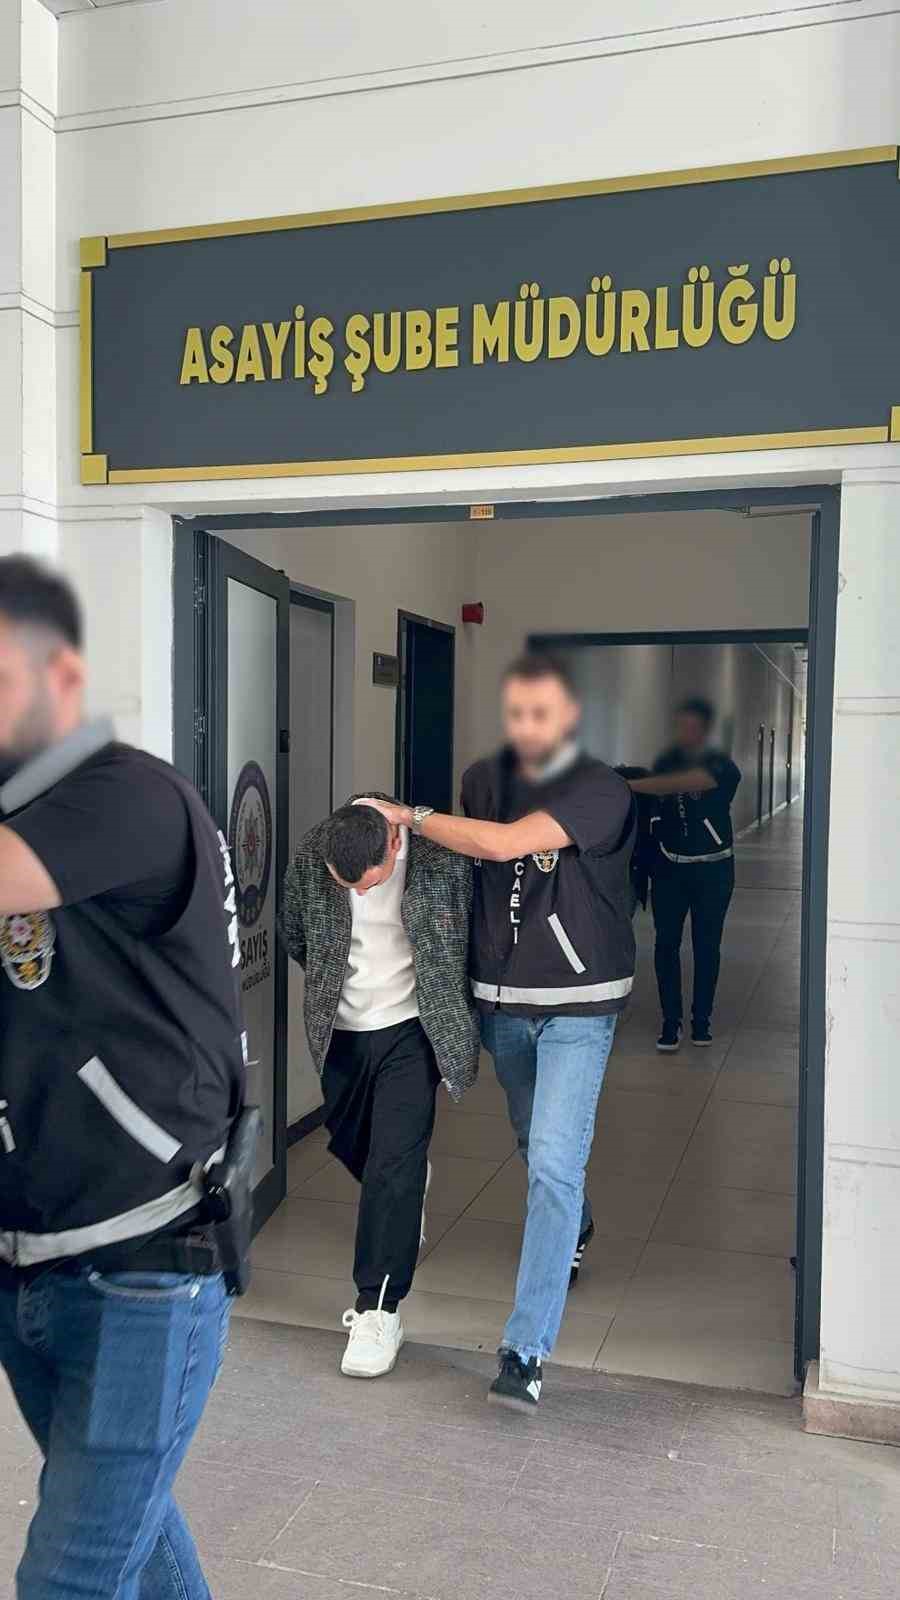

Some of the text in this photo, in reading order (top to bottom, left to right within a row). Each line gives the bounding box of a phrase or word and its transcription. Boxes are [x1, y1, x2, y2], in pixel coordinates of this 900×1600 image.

[179, 258, 796, 394] ASAYİŞ ŞUBE MÜDÜRLÜĞÜ
